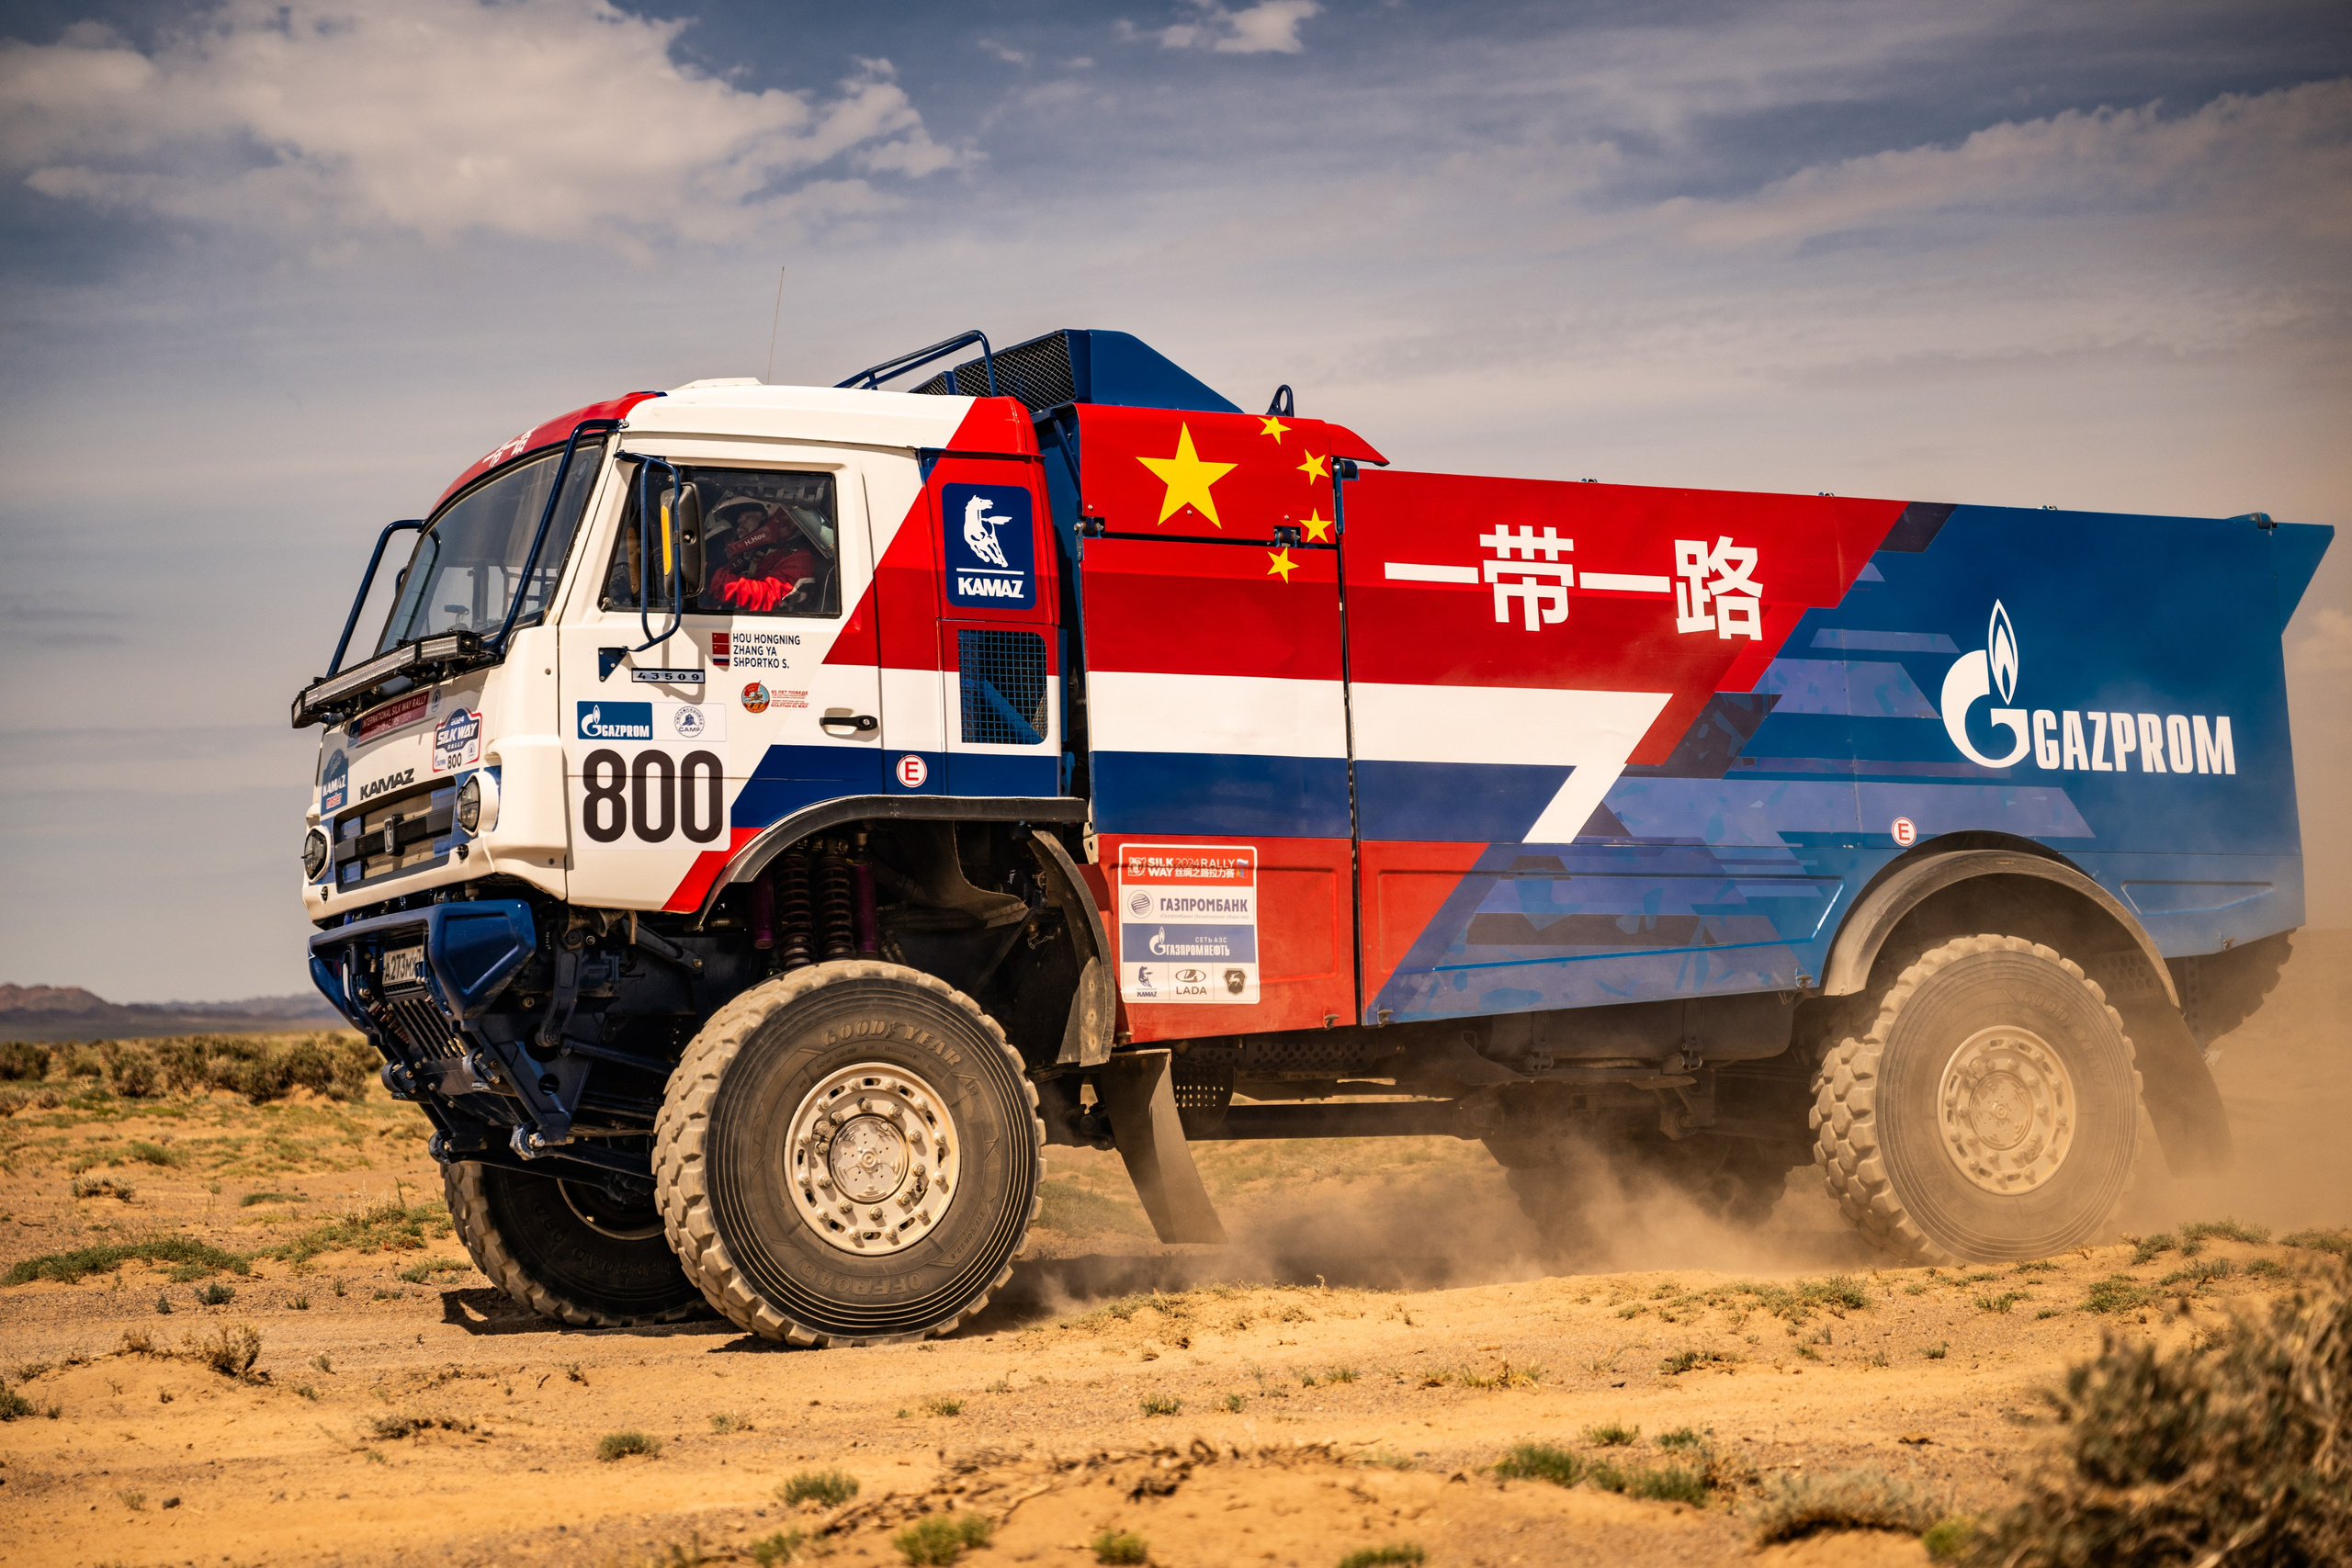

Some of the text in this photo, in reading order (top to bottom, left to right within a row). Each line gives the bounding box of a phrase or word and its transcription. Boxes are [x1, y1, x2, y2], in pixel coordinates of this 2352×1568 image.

[743, 533, 766, 547] H.Hou
[957, 576, 1024, 599] KAMAZ
[1384, 524, 1764, 641] 一带一路
[732, 633, 801, 646] HOU HONGNING
[733, 645, 777, 657] ZHANG YA
[733, 657, 790, 669] SHPORTKO S.
[637, 671, 700, 682] 43509
[436, 722, 478, 746] SILK WAY
[601, 724, 650, 738] GAZPROM
[447, 740, 464, 750] RALLY
[2032, 709, 2236, 775] GAZPROM
[447, 752, 462, 770] 800
[904, 761, 920, 781] E
[322, 773, 346, 797] KAMAZ
[359, 767, 414, 801] KAMAZ
[582, 748, 724, 843] 800
[1897, 822, 1911, 841] E
[1148, 857, 1236, 869] SILK 2024 RALLY
[1148, 867, 1173, 877] WAY
[1174, 868, 1235, 879] 丝绸之路拉力赛
[1159, 897, 1249, 912] ГАЗПРОМБАНК
[1166, 944, 1230, 956] ГАЗПРОМНЕФТЬ
[1175, 986, 1207, 995] LADA
